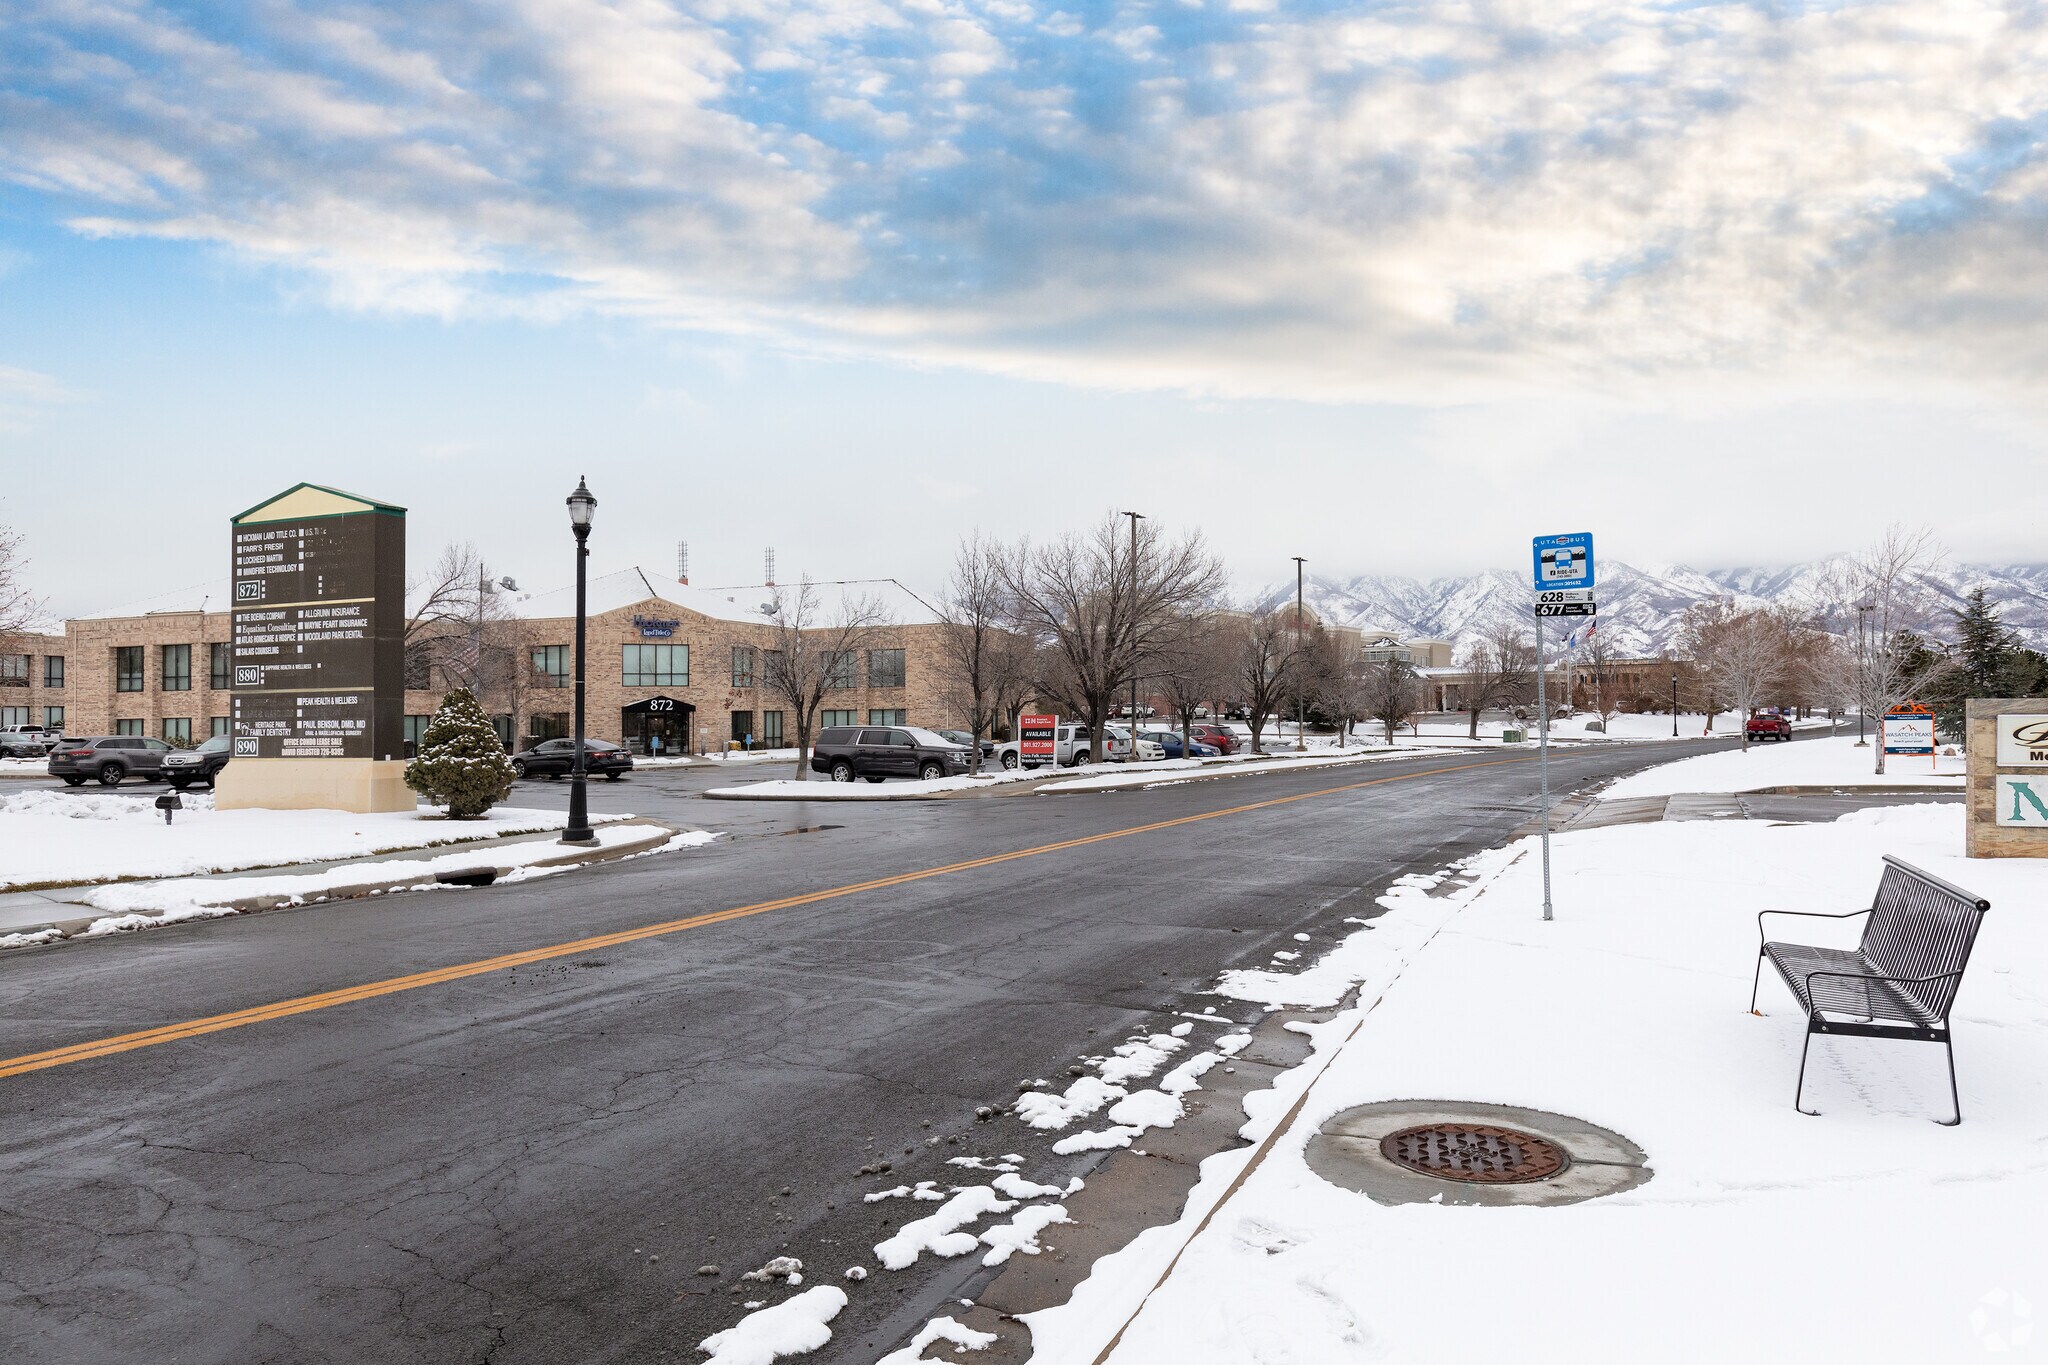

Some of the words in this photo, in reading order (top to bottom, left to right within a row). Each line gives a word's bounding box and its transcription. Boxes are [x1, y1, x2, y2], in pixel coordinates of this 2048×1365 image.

[243, 533, 262, 542] HICKMAN
[263, 532, 275, 540] LAND
[243, 545, 263, 553] FARR'S
[265, 543, 284, 551] FRESH
[243, 556, 265, 564] LOCKHEED
[266, 554, 283, 562] MARTIN
[244, 566, 266, 575] MINDFIRE
[267, 564, 297, 574] TECHNOLOGY
[239, 584, 257, 597] 872
[1541, 592, 1564, 602] 628
[332, 607, 360, 616] INSURANCE
[1541, 605, 1564, 615] 677
[242, 614, 250, 622] THE
[251, 613, 266, 621] BOEING
[267, 612, 286, 620] COMPANY
[633, 615, 680, 628] Hickman
[242, 624, 266, 635] Equation
[268, 623, 296, 632] Consulting
[304, 621, 322, 629] WAYNE
[322, 620, 338, 628] PEART
[339, 619, 368, 628] INSURANCE
[254, 635, 274, 643] HOMECARE
[279, 634, 296, 642] HOSPICE
[304, 632, 331, 641] WOODLAND
[332, 631, 345, 639] PARK
[346, 630, 363, 638] DENTAL
[255, 647, 279, 655] COUNSELING
[238, 670, 256, 682] 880
[303, 698, 313, 706] PEAK
[313, 697, 330, 705] HEALTH
[331, 697, 335, 705] &
[335, 696, 358, 705] WELLNESS
[650, 700, 674, 711] 872
[303, 721, 316, 729] PAUL
[318, 720, 340, 729] BENSON,
[341, 720, 355, 729] DMD,
[357, 720, 366, 728] MD
[238, 740, 256, 753] 890
